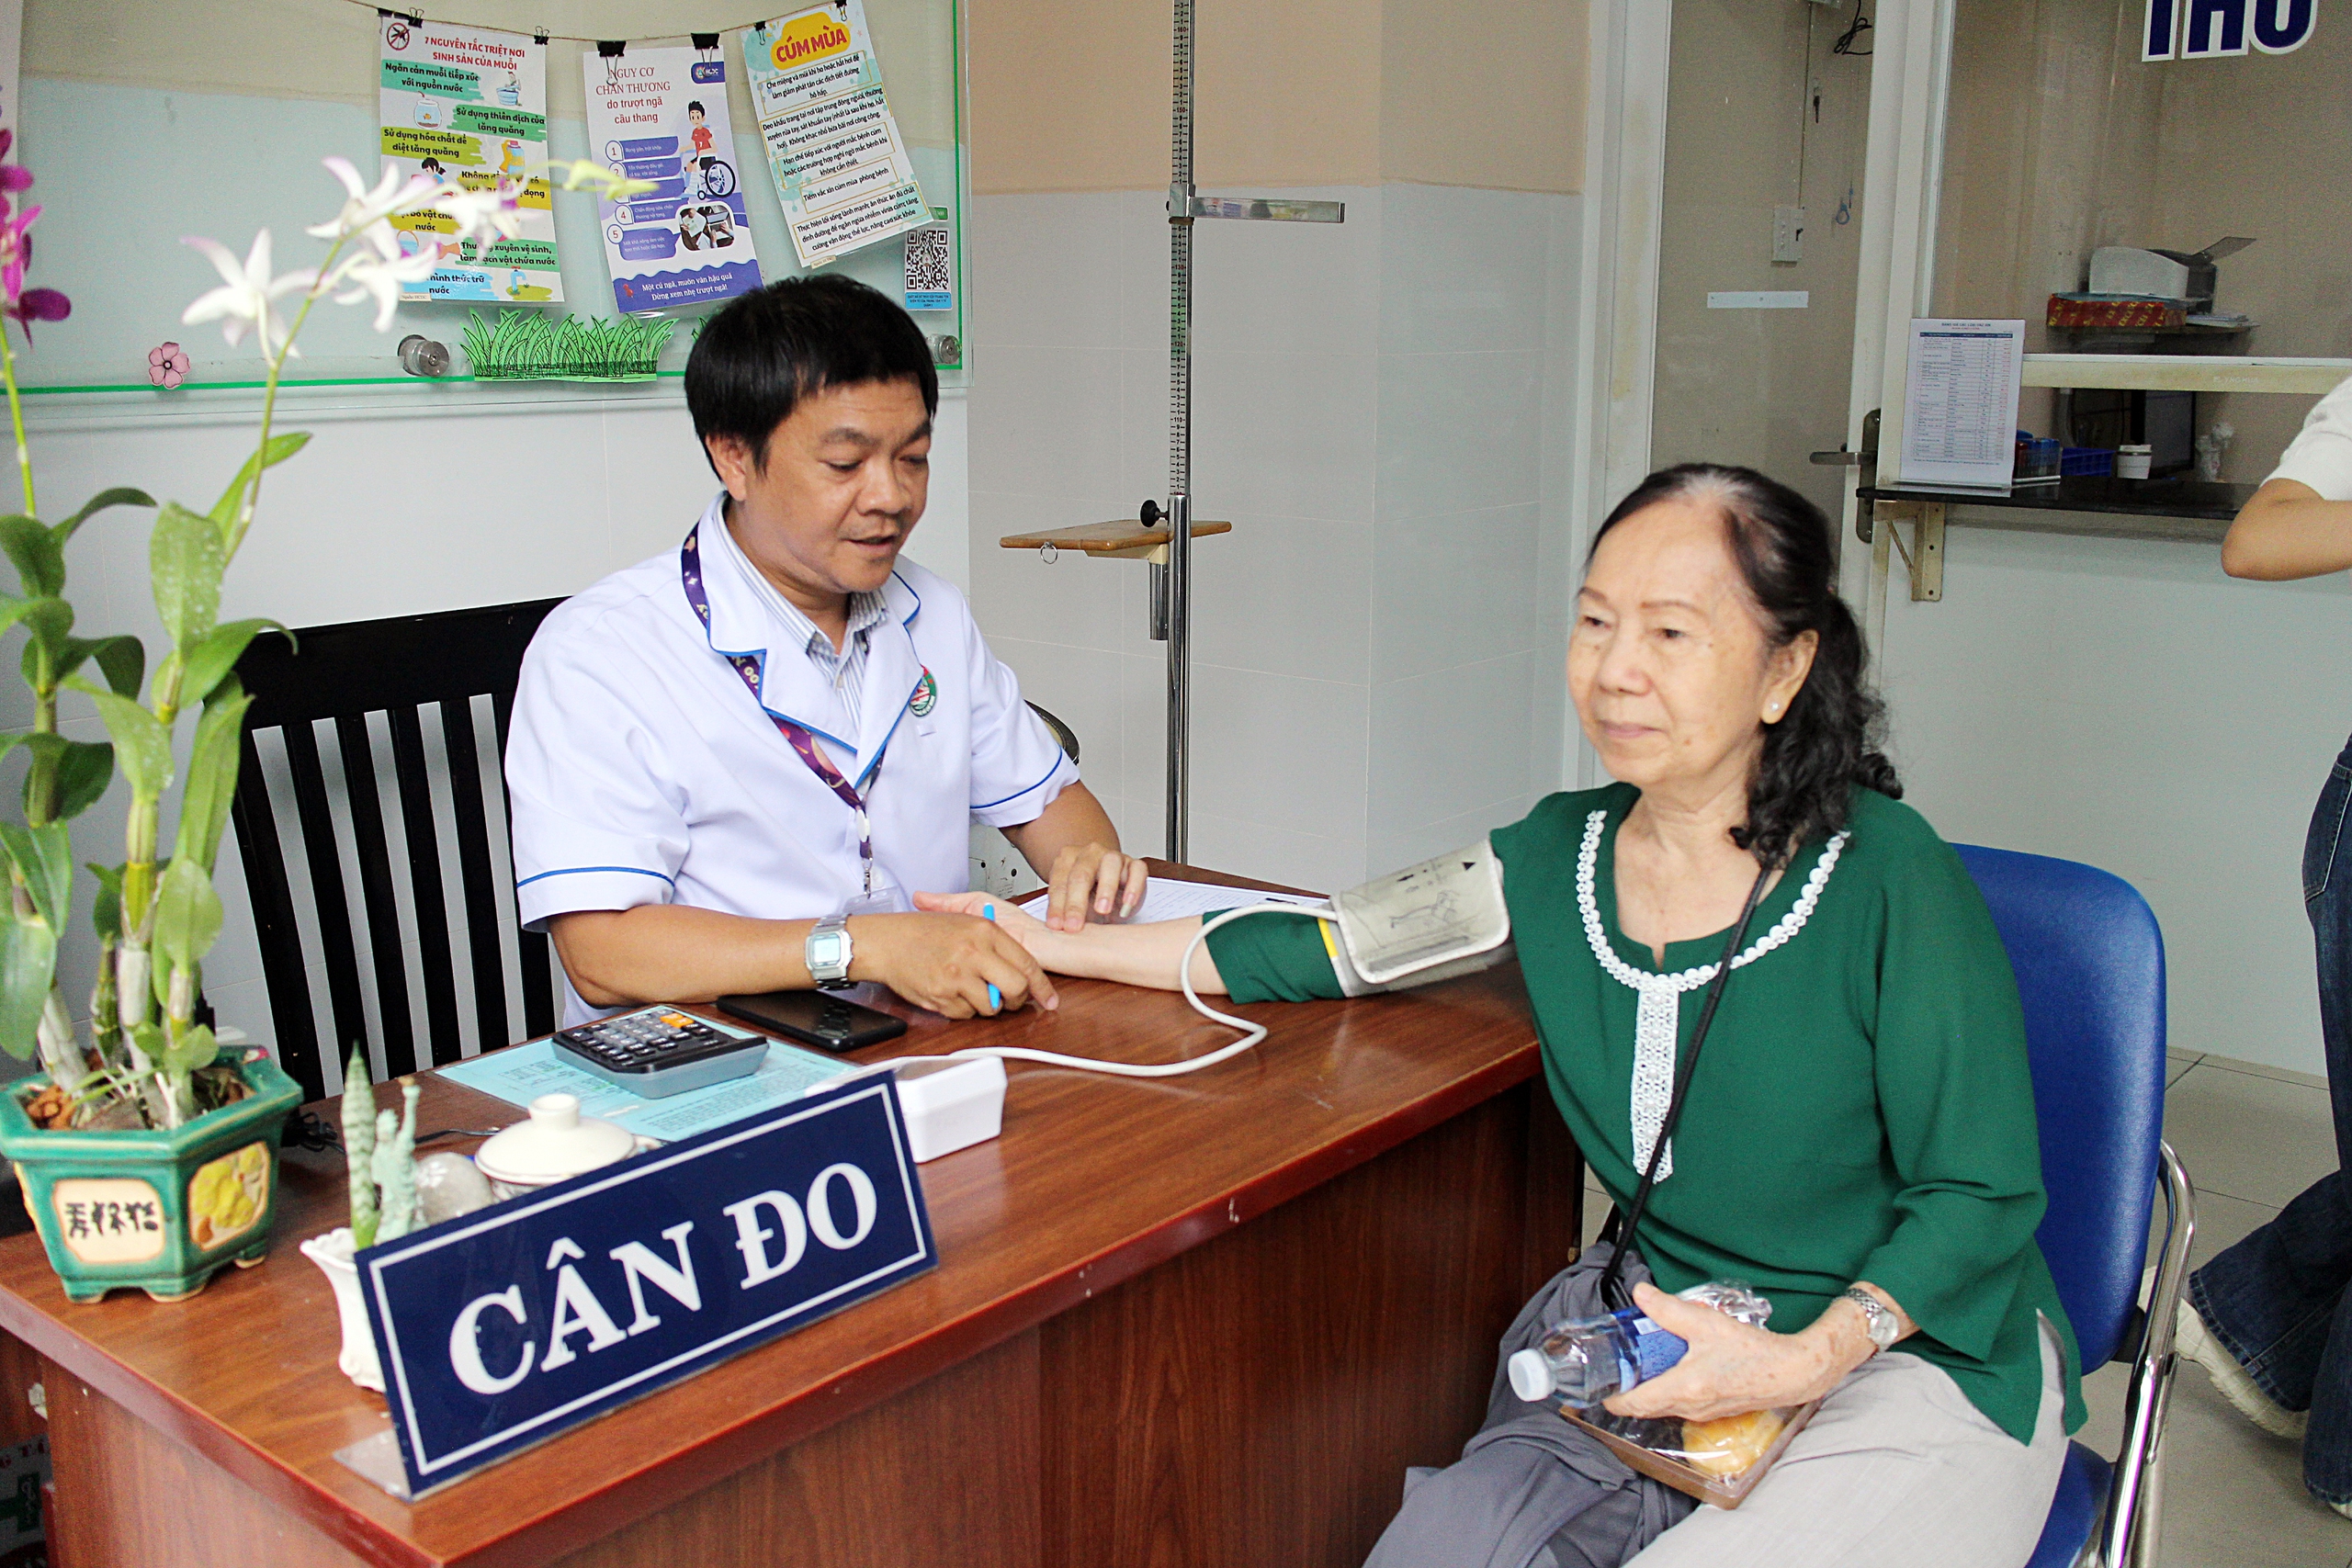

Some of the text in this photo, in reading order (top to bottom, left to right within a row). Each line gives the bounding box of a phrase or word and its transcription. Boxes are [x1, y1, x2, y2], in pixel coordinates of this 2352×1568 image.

[430, 38, 466, 49] NGUYÊN
[468, 42, 482, 51] TẮC
[484, 44, 507, 55] TRIỆT
[509, 49, 526, 57] NƠI
[776, 25, 847, 62] CÚM MÙA
[433, 51, 517, 70] SINH SẢN CỦA MUỖI
[385, 62, 479, 81] Ngăn cản muỗi tiếp xúc
[609, 67, 655, 78] NGUY CƠ
[401, 76, 463, 93] với nguồn nước
[607, 96, 663, 109] do trượt ngã
[615, 113, 659, 124] cầu thang
[477, 121, 525, 136] lăng quăng
[611, 147, 616, 156] 1
[424, 209, 437, 220] vật
[620, 210, 627, 220] 4
[415, 222, 436, 231] nước
[613, 230, 618, 239] 5
[495, 243, 520, 254] xuyên
[521, 243, 530, 254] vệ
[499, 254, 513, 265] vật
[536, 256, 556, 265] nước
[428, 285, 450, 295] nước
[448, 1162, 878, 1394] CÂN ĐO
